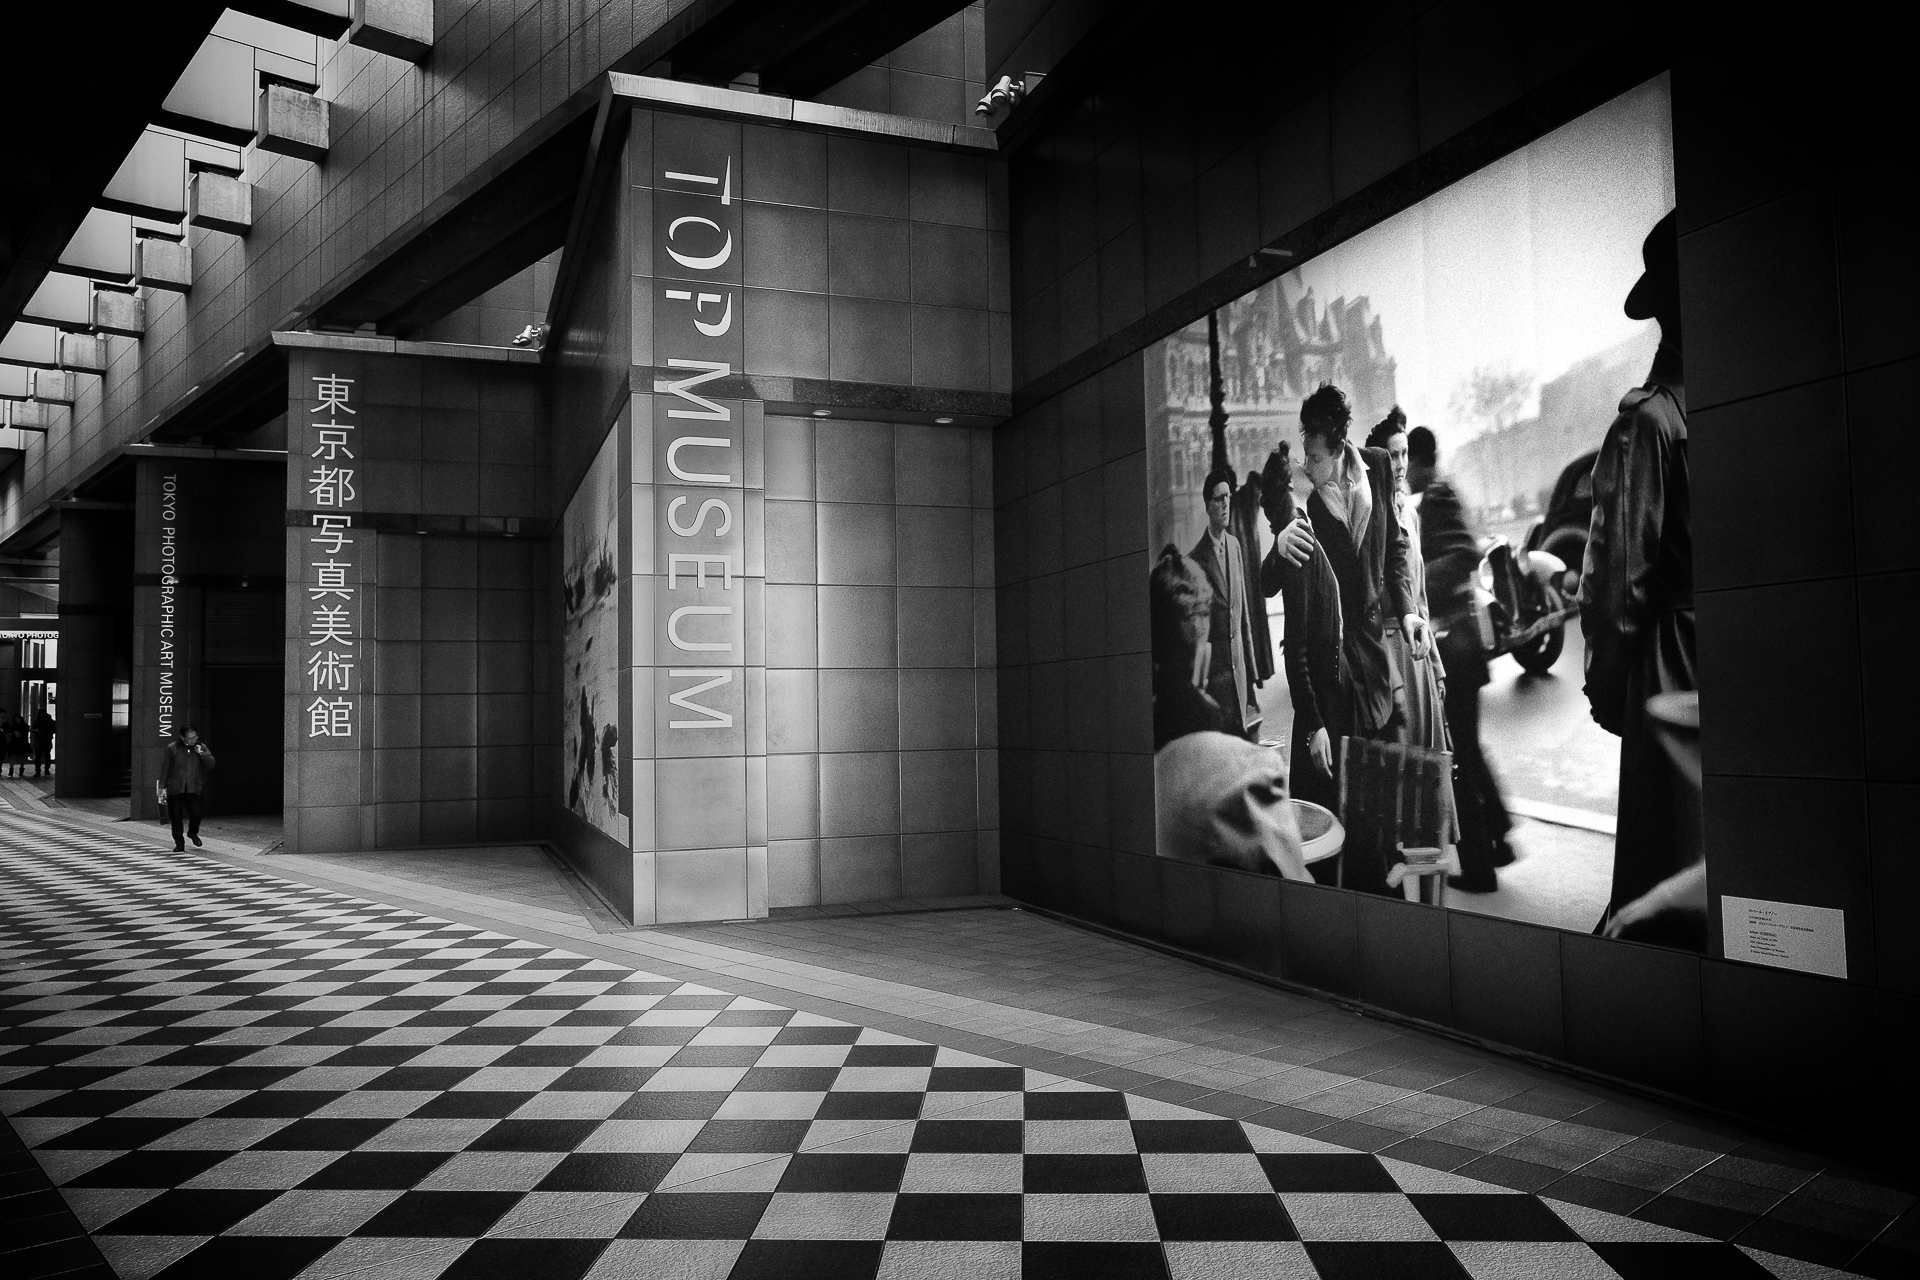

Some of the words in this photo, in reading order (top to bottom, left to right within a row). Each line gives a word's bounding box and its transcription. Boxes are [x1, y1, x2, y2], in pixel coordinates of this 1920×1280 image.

[664, 155, 733, 337] TOP
[162, 474, 176, 520] TOKYO
[665, 357, 733, 730] MUSEUM
[160, 527, 176, 638] PHOTOGRAPHIC
[306, 373, 356, 738] 東京都写真美術館
[158, 672, 173, 737] MUSEUM
[160, 640, 174, 669] ART
